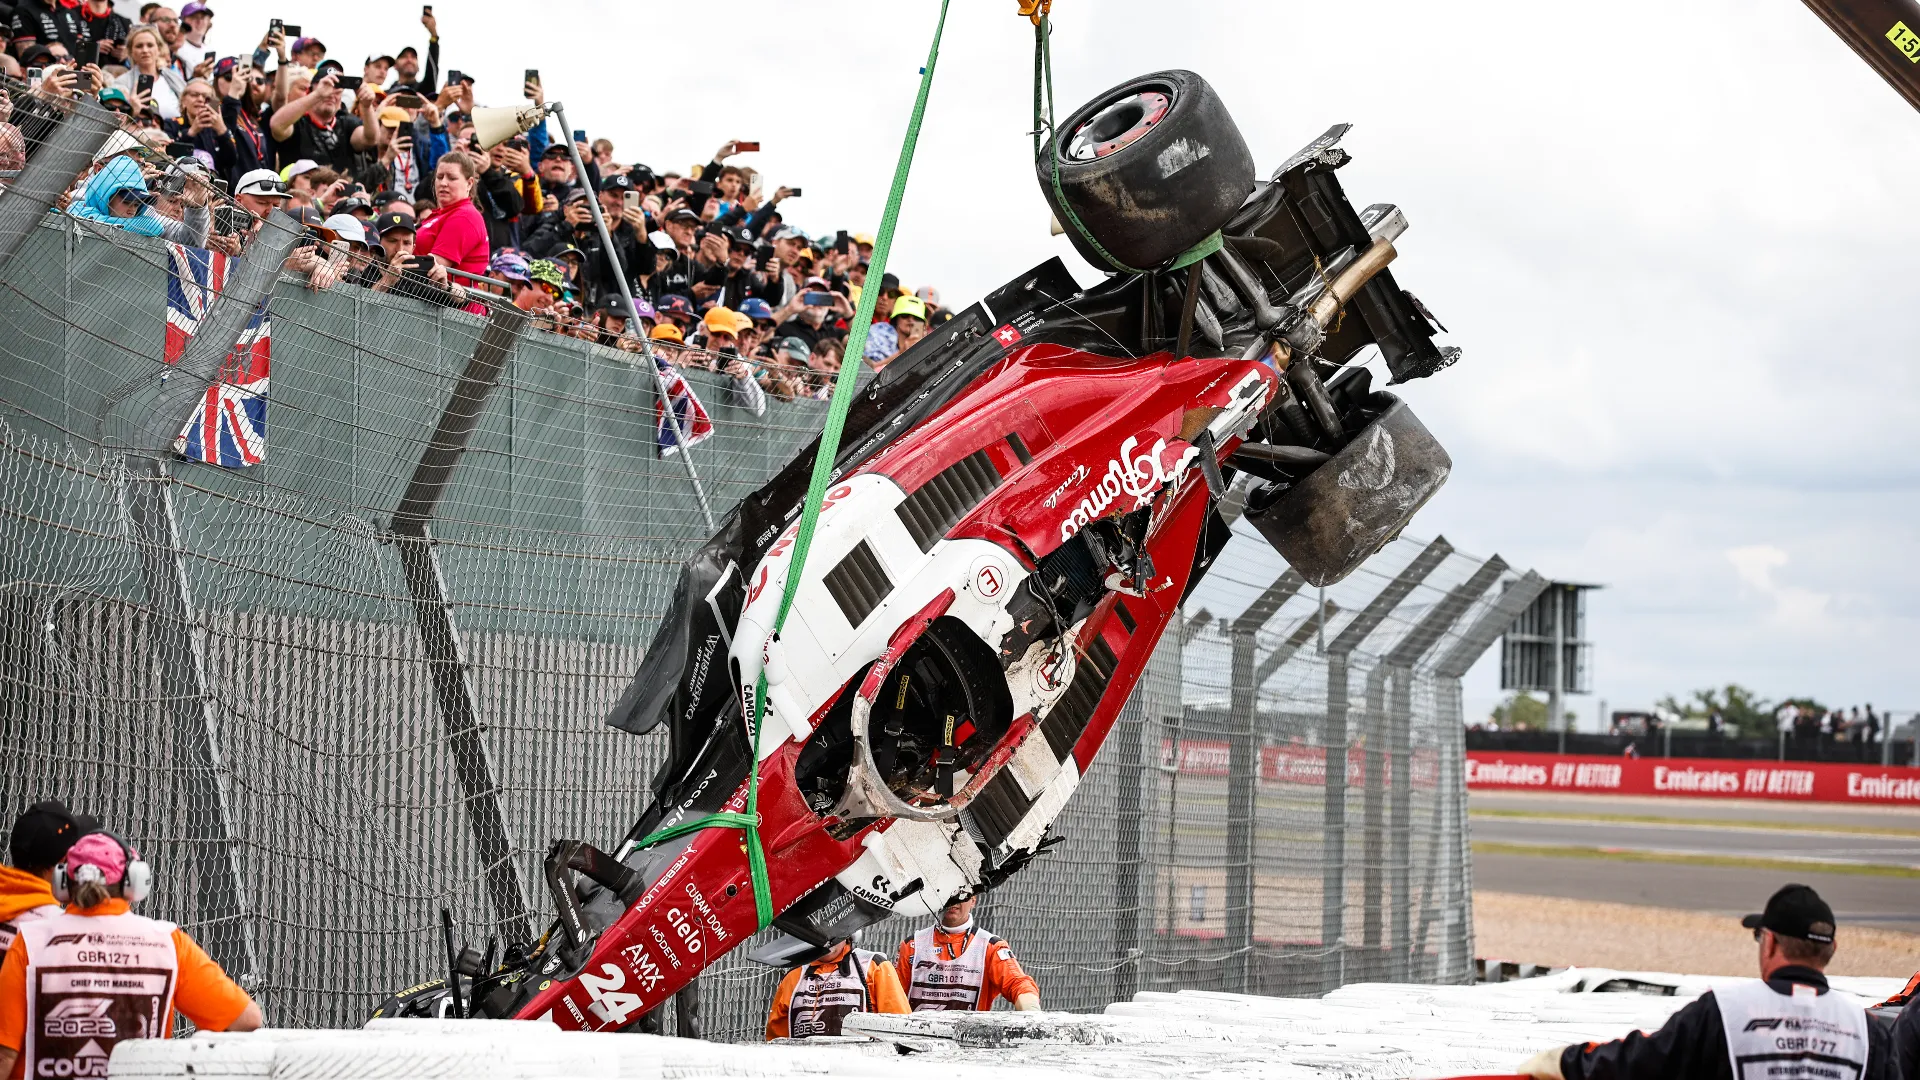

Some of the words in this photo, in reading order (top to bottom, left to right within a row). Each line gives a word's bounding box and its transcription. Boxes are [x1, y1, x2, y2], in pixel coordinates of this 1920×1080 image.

[1575, 763, 1622, 788] BETTER
[1653, 765, 1739, 793] Emirates
[1743, 768, 1766, 793] FLY
[1766, 769, 1815, 795] BETTER
[635, 853, 689, 913] REBELLION
[853, 885, 896, 909] CAMOZZI
[685, 882, 710, 918] CURAM
[706, 913, 728, 942] DOMI
[666, 907, 702, 954] cielo
[625, 943, 664, 989] AMX
[71, 979, 91, 988] CHIEF
[112, 980, 145, 989] MARSHAL
[578, 962, 644, 1024] 24
[44, 1020, 116, 1038] 2022
[37, 1057, 108, 1077] COUR
